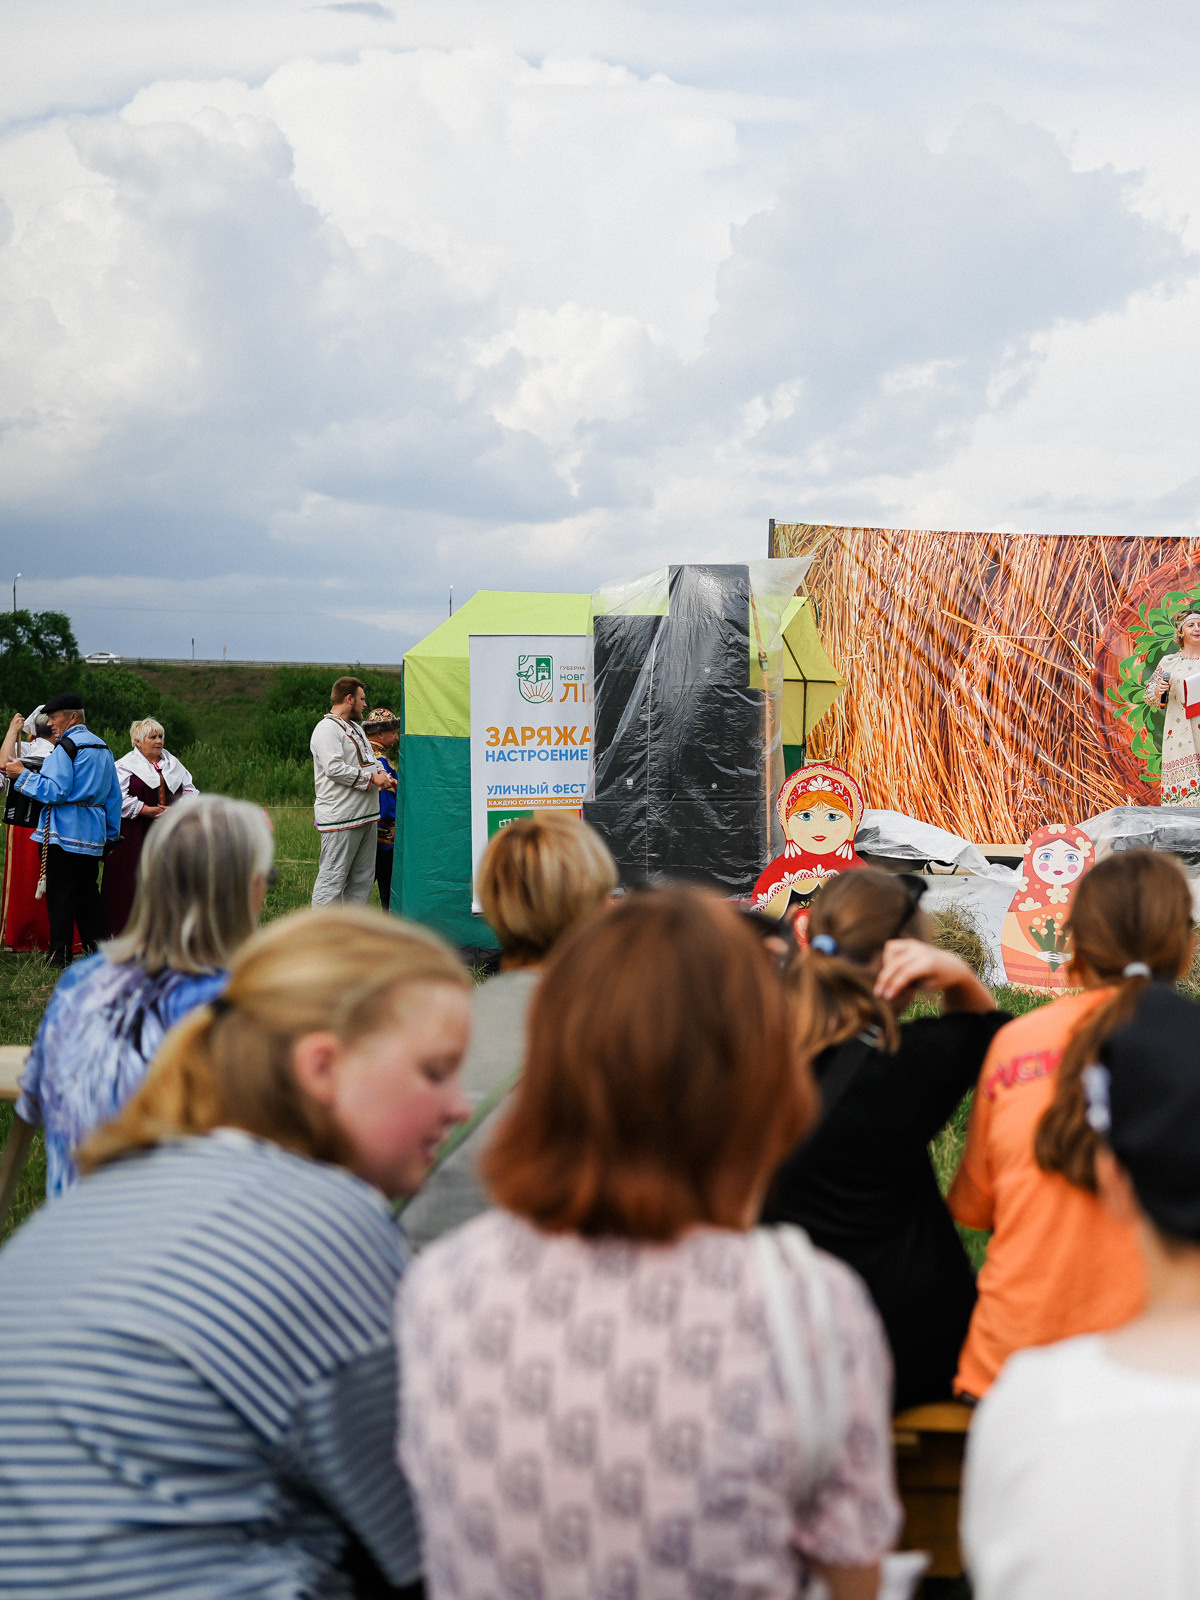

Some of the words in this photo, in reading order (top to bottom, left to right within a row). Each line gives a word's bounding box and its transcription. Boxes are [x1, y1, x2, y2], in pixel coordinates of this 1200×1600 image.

[559, 673, 587, 681] НОВГ
[485, 726, 592, 747] ЗАРЯЖА
[485, 749, 589, 762] НАСТРОЕНИЕ
[487, 782, 549, 796] УЛИЧНЫЙ
[552, 783, 588, 795] ФЕСТ
